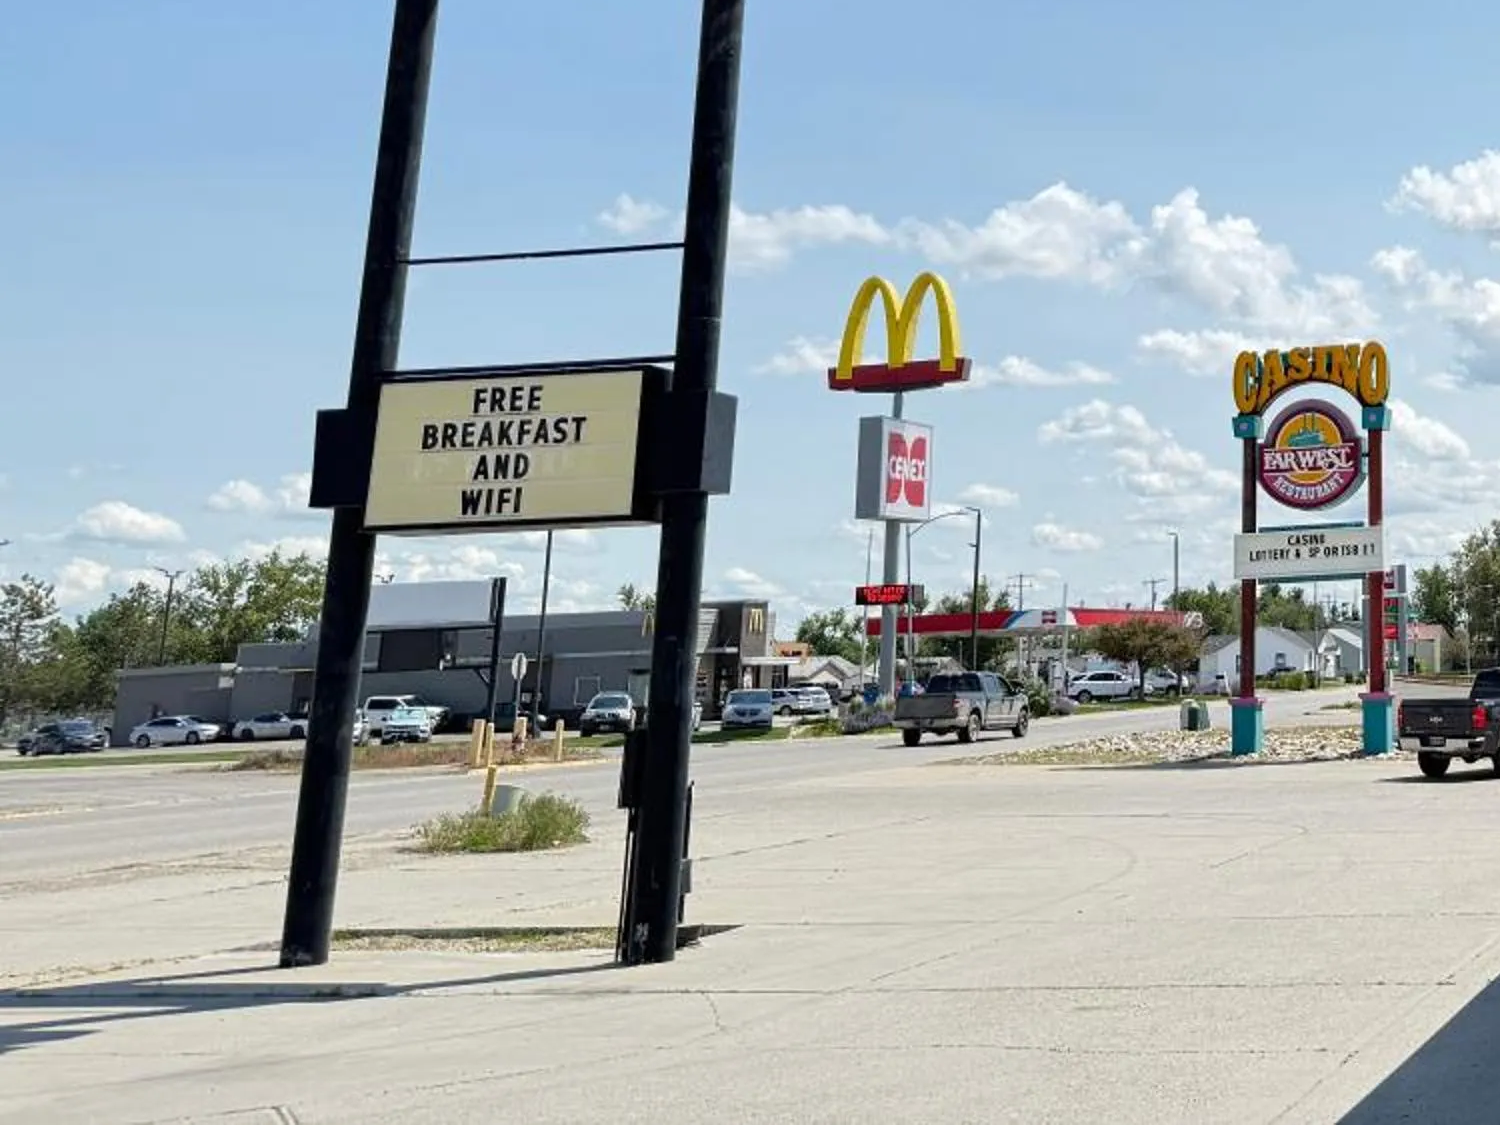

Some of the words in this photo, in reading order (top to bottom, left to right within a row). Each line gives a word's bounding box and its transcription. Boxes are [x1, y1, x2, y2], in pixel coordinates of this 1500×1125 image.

[1233, 341, 1389, 414] CASINO
[473, 385, 544, 414] FREE
[421, 416, 587, 451] BREAKFAST
[473, 454, 529, 481] AND
[1273, 472, 1345, 501] RESTAURANT
[460, 487, 523, 516] WIFI
[1287, 534, 1326, 546] CASINO
